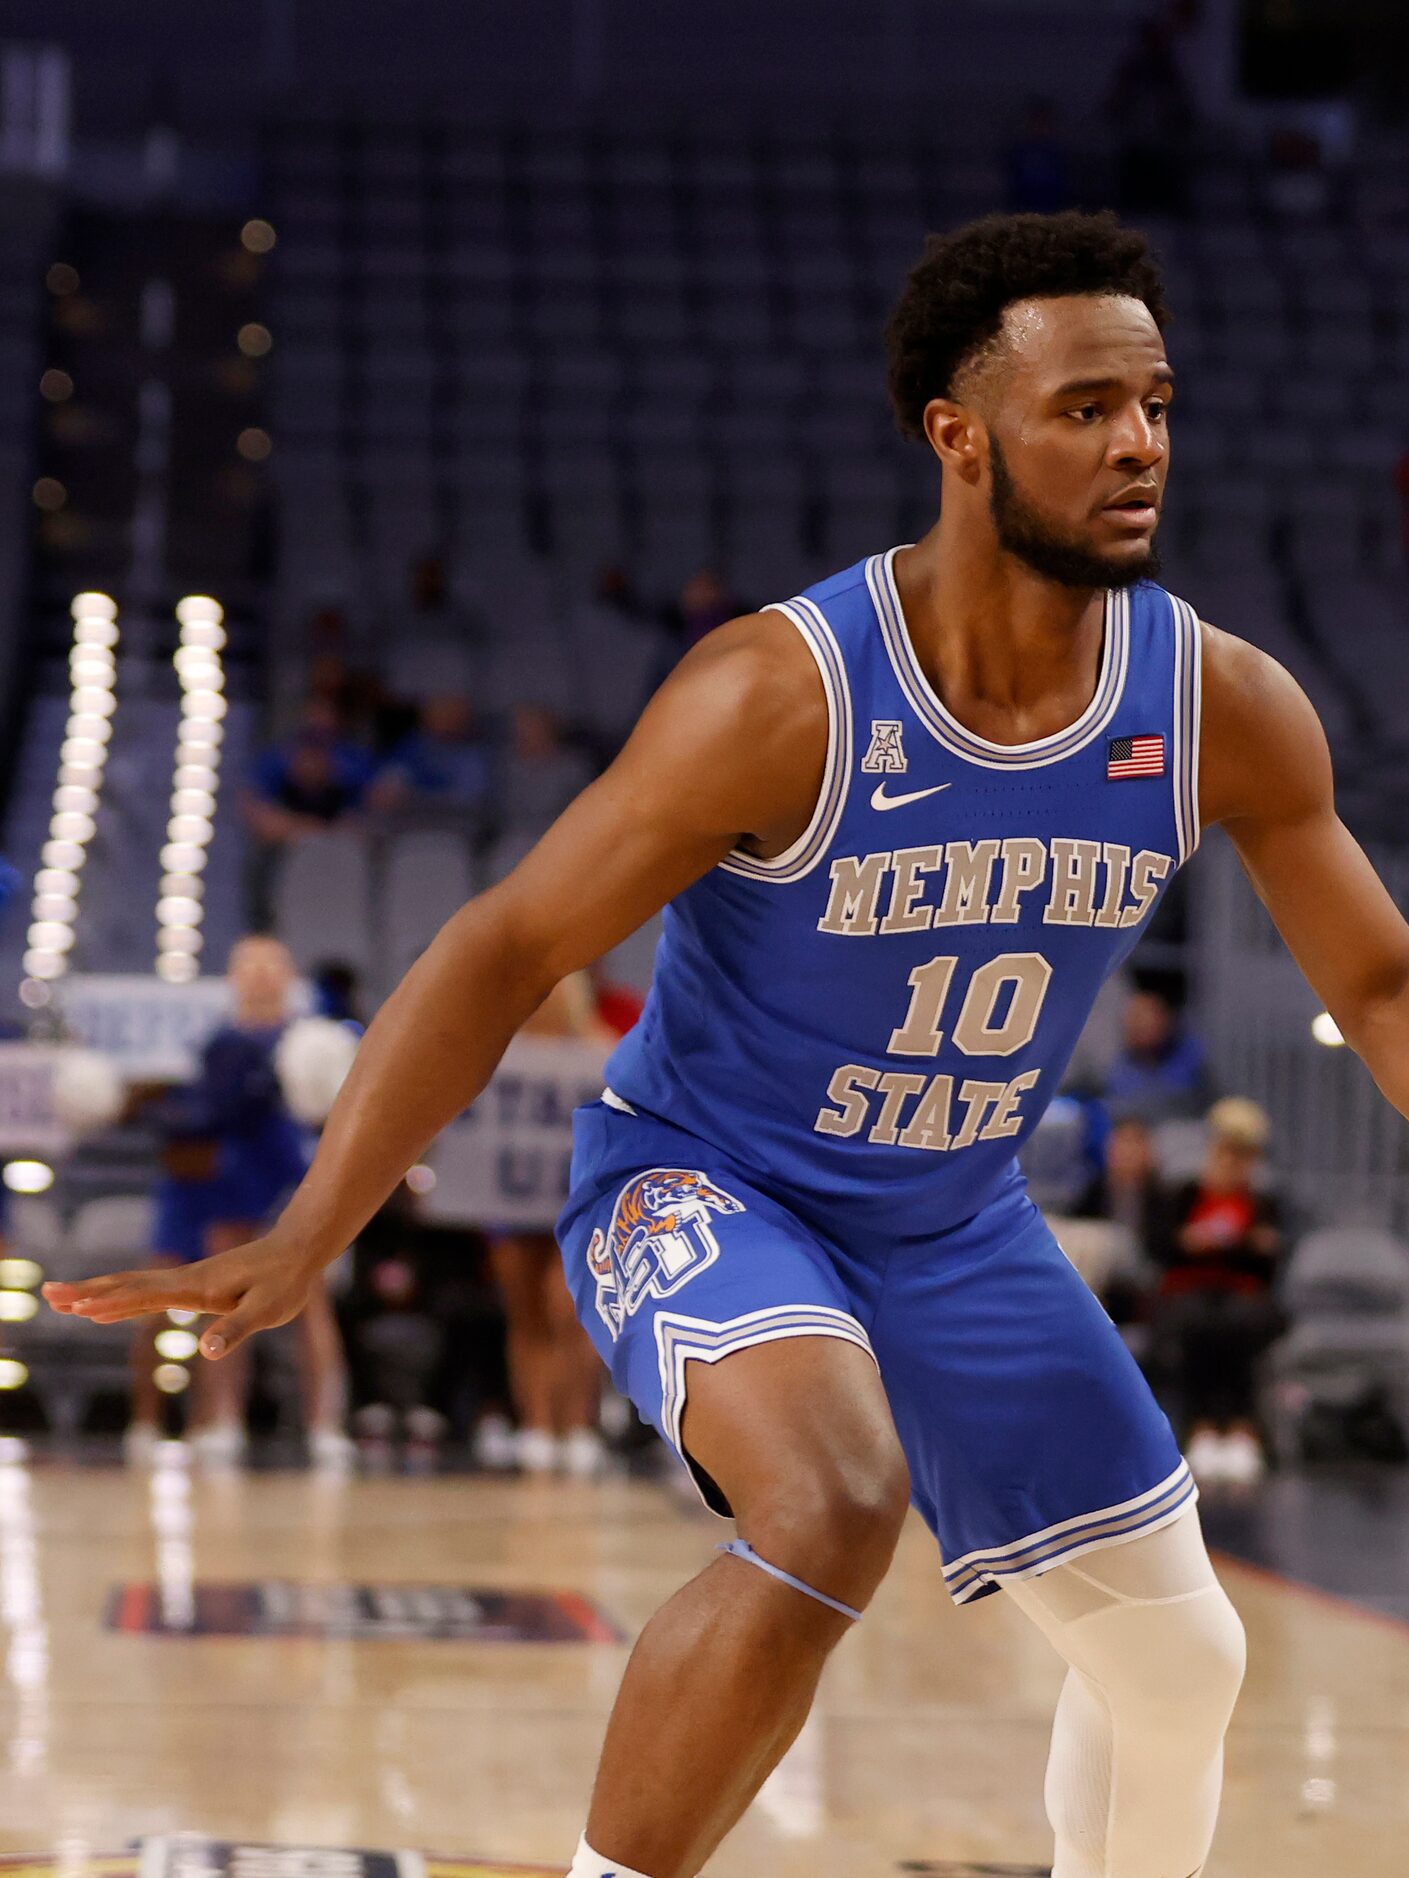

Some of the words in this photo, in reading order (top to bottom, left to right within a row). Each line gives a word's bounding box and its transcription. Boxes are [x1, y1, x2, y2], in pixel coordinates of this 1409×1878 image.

[816, 837, 1176, 937] MEMPHIS
[886, 951, 1054, 1057] 10
[813, 1062, 1043, 1153] STATE
